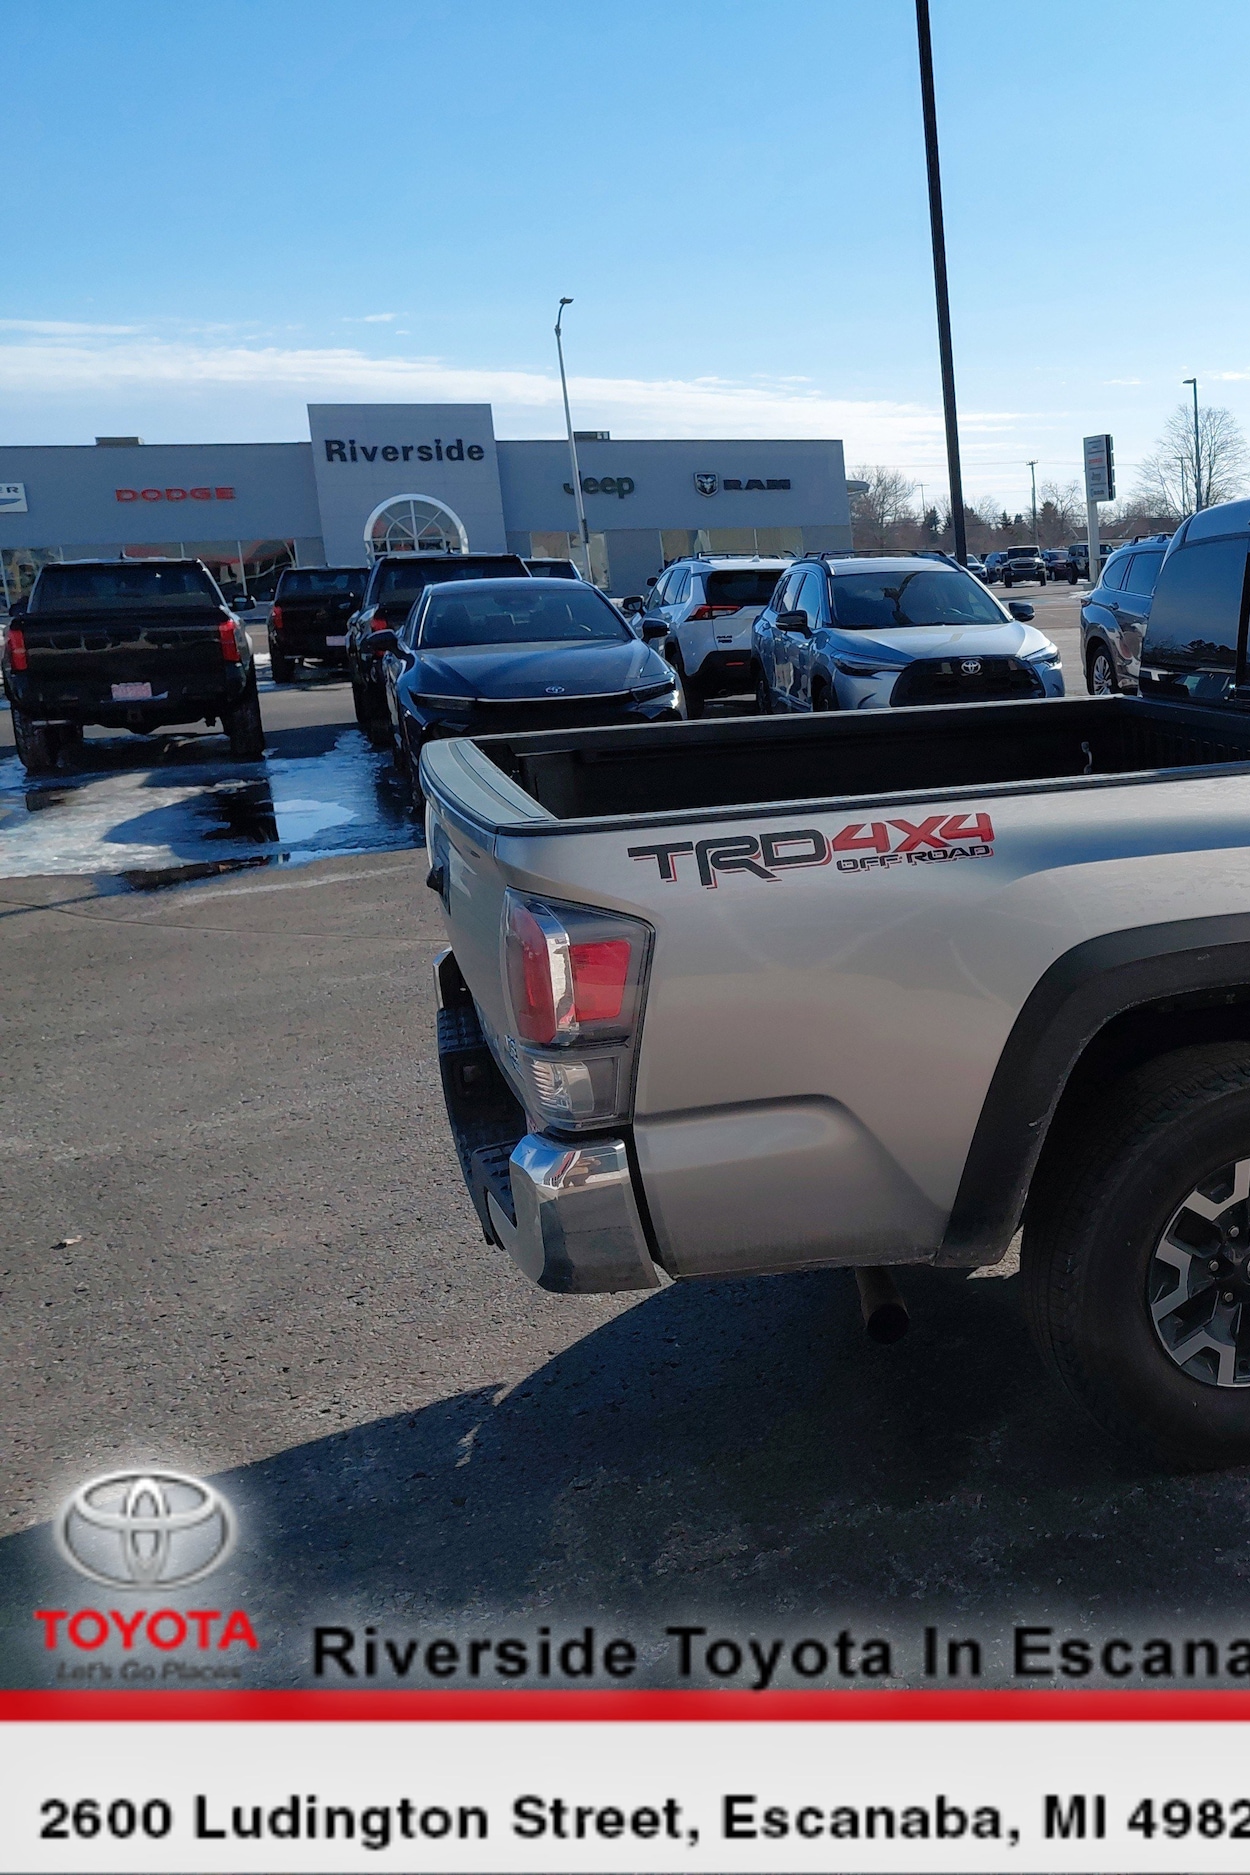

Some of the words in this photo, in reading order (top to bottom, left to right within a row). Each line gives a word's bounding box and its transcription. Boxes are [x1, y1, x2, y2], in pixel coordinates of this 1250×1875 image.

[324, 439, 485, 463] Riverside
[115, 487, 236, 502] DODGE
[563, 471, 634, 499] Jeep
[723, 479, 791, 490] RAM
[627, 829, 833, 889] TRD
[836, 854, 902, 873] OFF
[907, 844, 994, 868] ROAD
